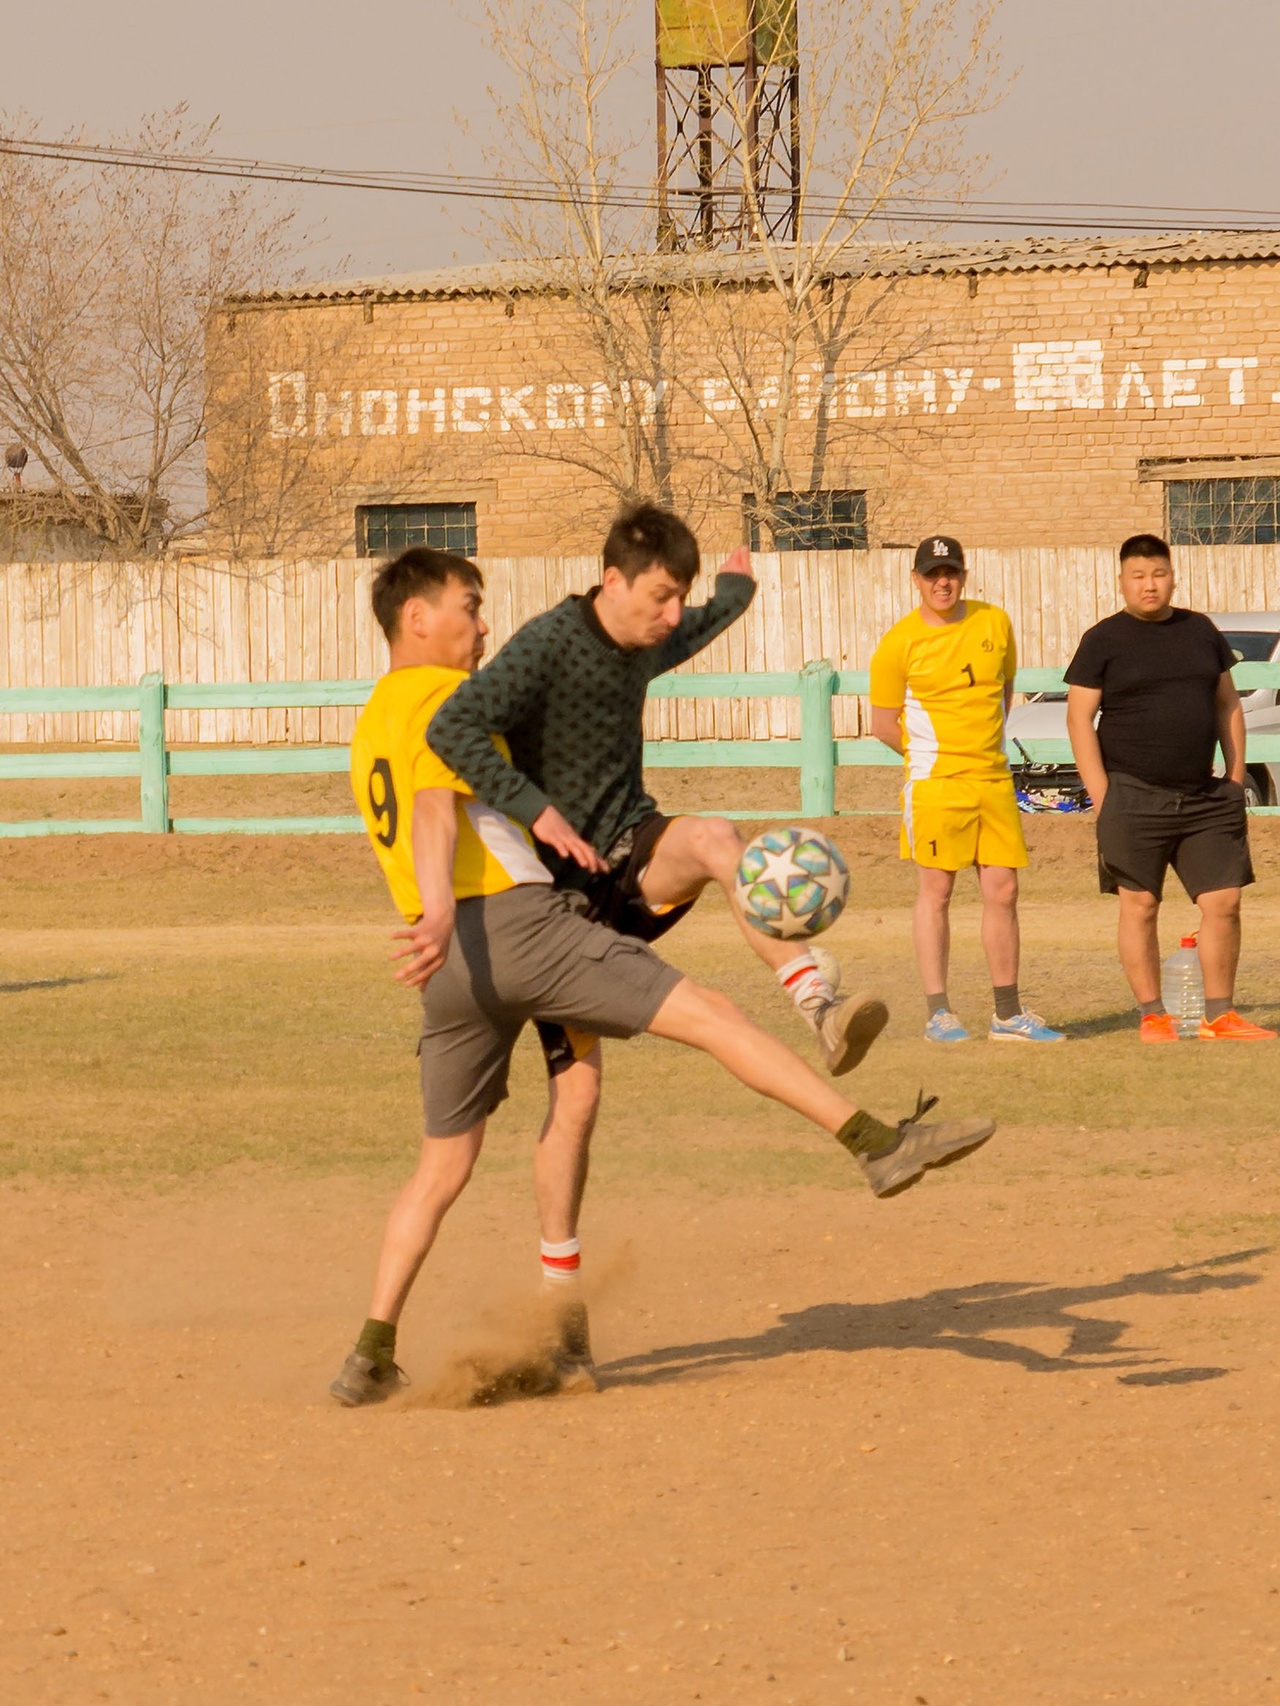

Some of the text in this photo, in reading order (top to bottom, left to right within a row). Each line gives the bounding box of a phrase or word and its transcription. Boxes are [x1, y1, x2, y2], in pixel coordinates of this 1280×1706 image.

[932, 539, 949, 556] LA
[960, 663, 976, 688] 1
[369, 758, 397, 848] 9
[928, 839, 937, 857] 1
